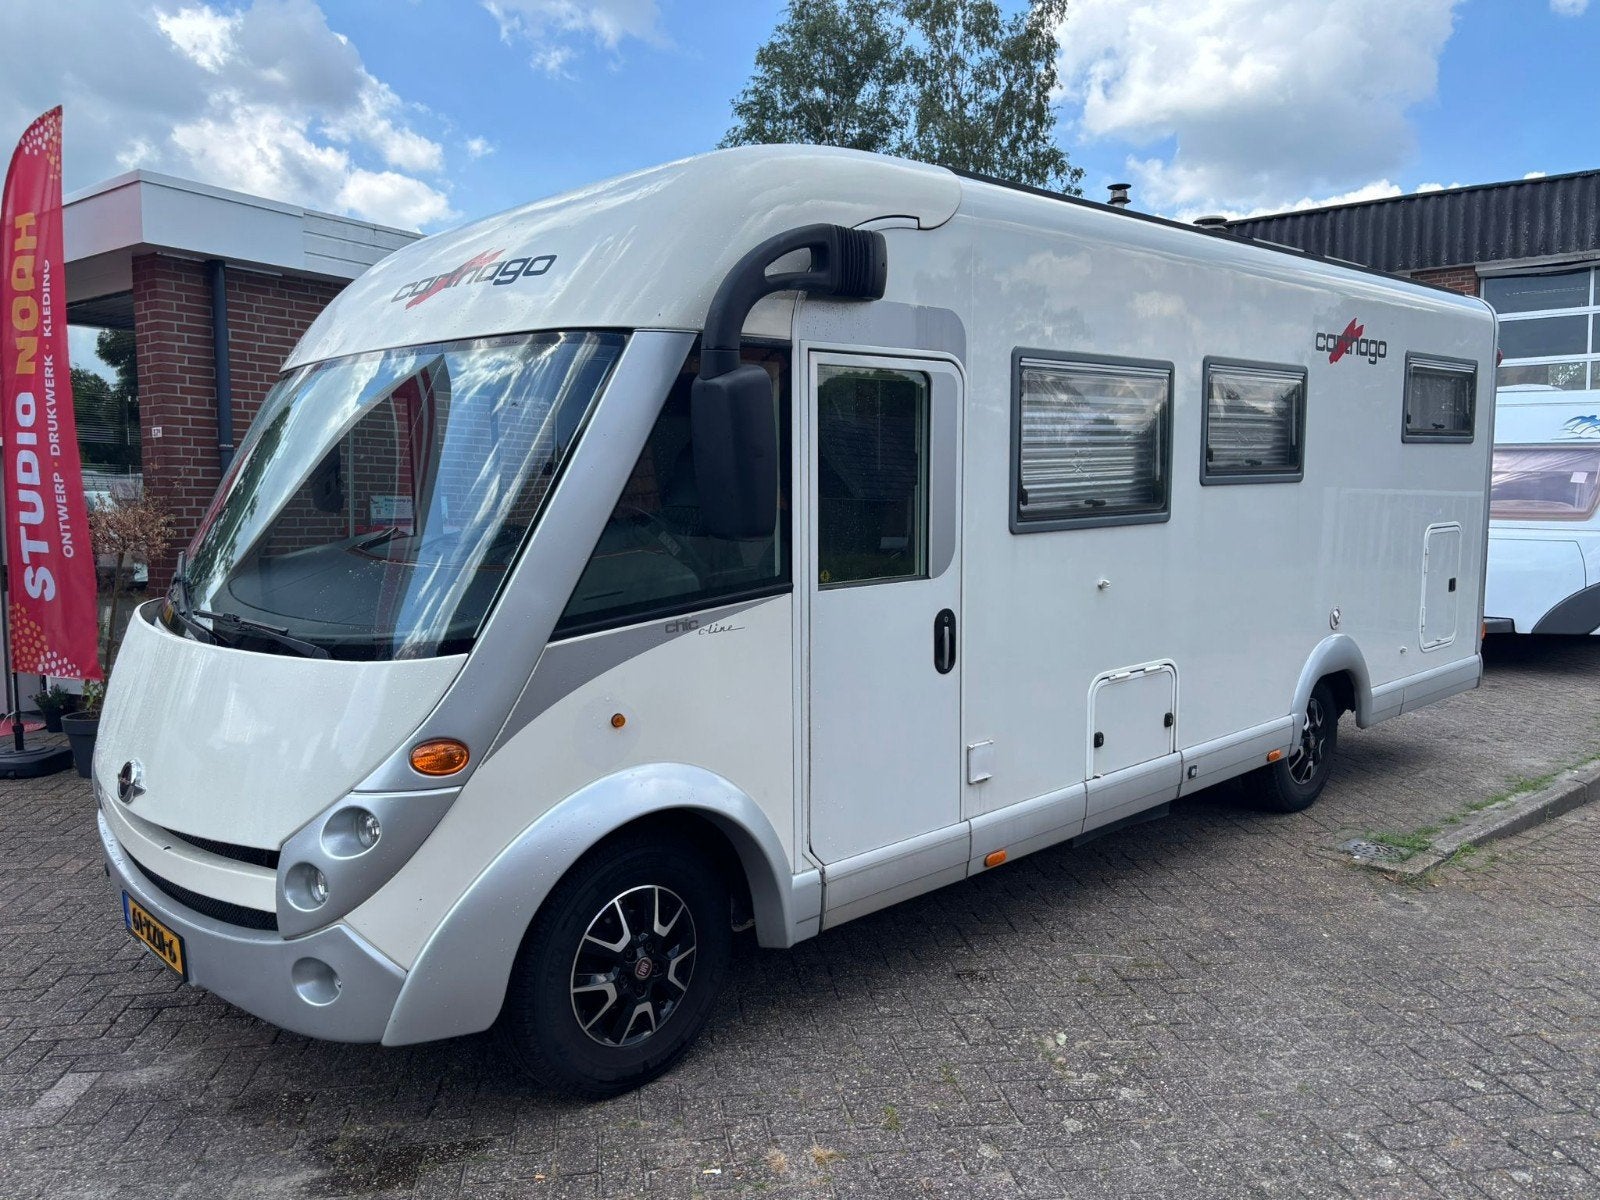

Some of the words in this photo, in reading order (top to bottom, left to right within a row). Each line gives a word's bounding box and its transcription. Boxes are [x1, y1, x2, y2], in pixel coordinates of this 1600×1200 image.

[11, 212, 39, 375] NOAH
[44, 354, 61, 457] DRUKWERK
[15, 391, 56, 602] STUDIO
[53, 472, 75, 559] ONTWERP
[664, 619, 699, 634] chic
